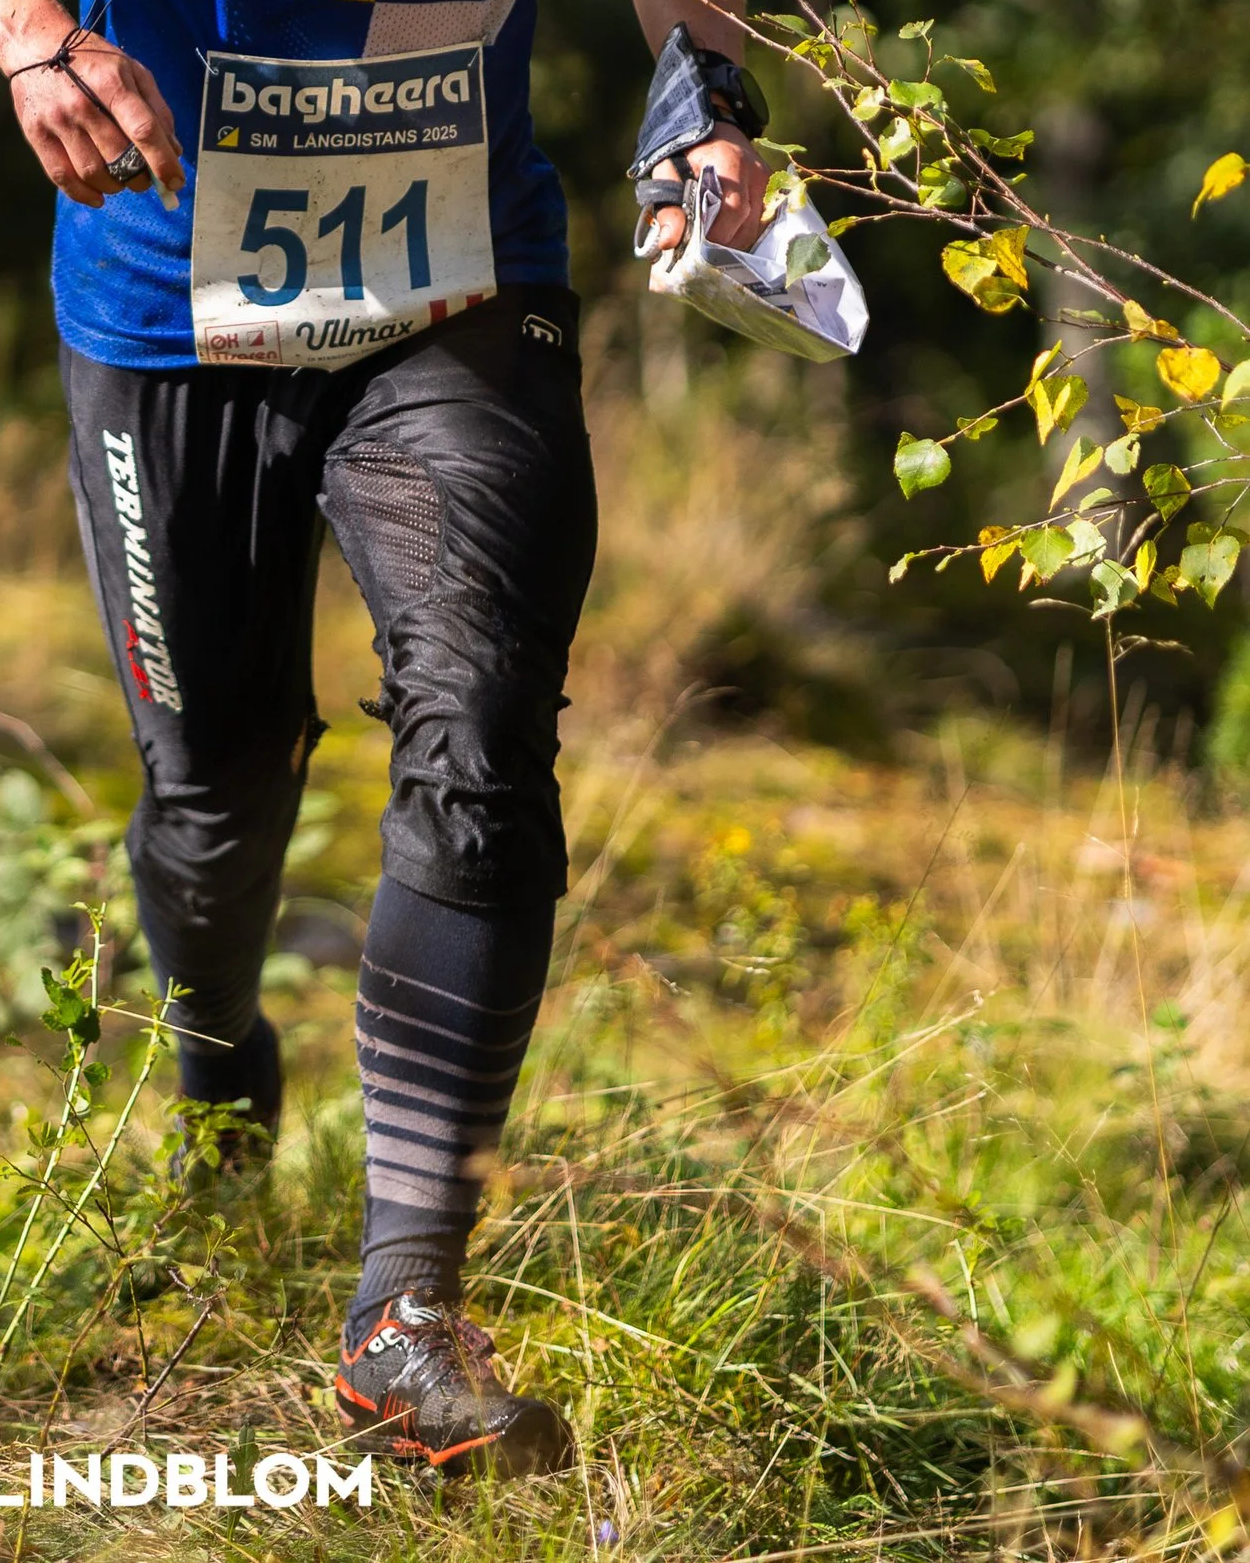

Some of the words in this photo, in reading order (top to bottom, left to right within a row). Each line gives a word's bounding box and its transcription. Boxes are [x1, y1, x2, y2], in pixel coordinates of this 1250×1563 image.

[220, 68, 471, 124] bagheera
[250, 133, 278, 149] SM
[293, 129, 418, 149] LÅNGDISTANS
[421, 124, 458, 143] 2025
[237, 179, 432, 307] 511
[210, 333, 240, 350] OK
[296, 319, 414, 350] Ullmax
[103, 429, 183, 714] TERMINATOR
